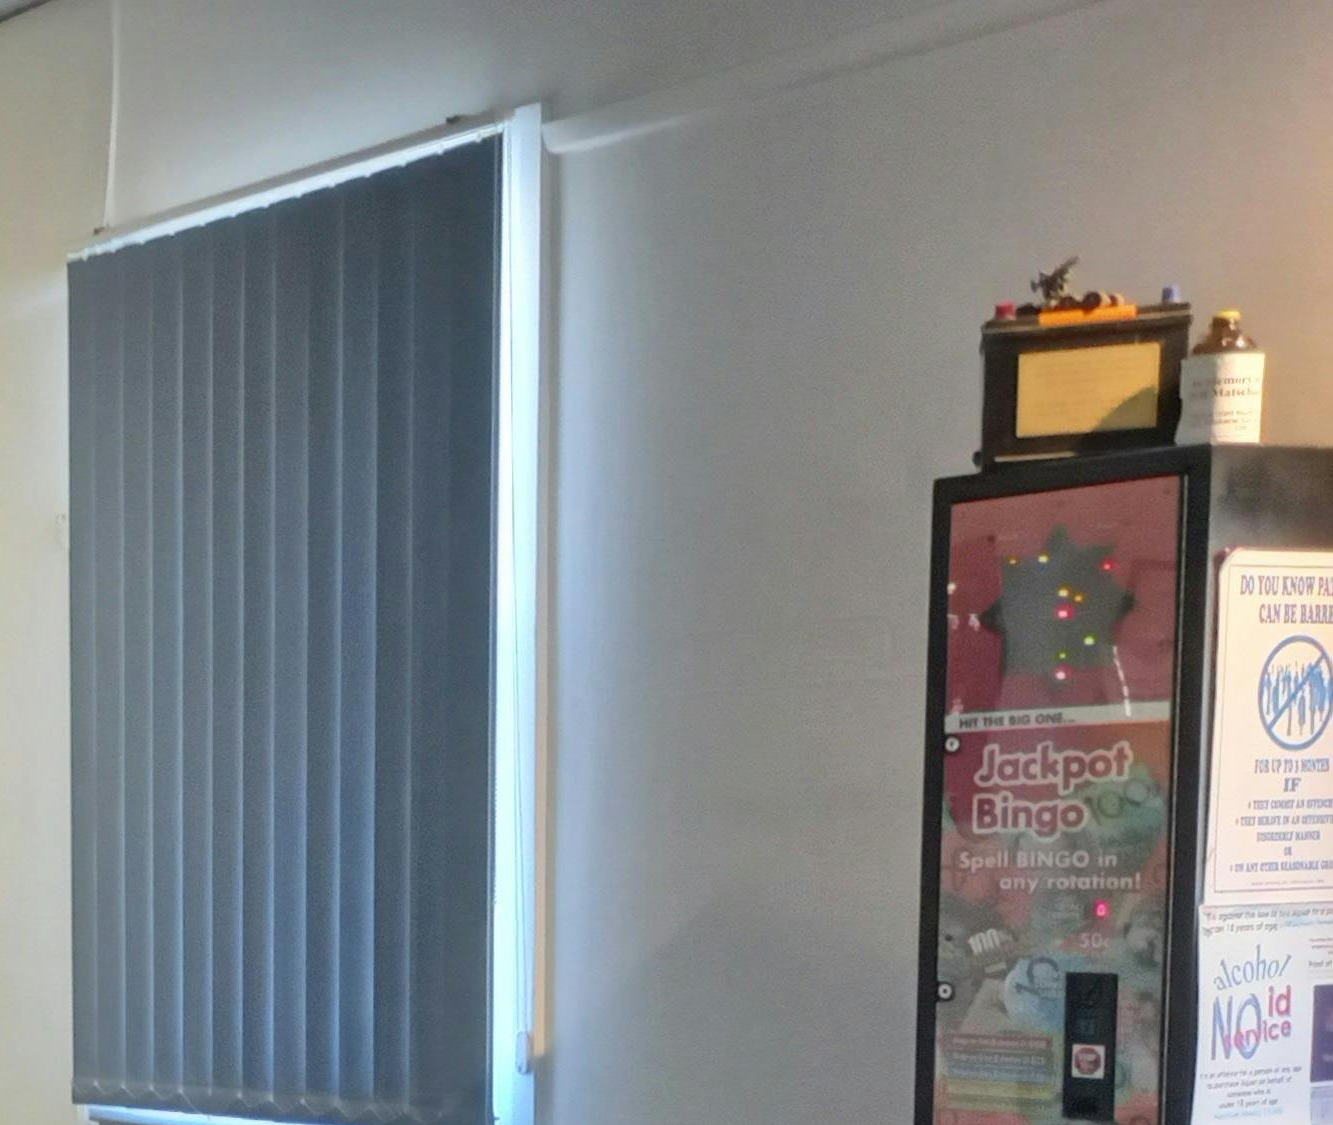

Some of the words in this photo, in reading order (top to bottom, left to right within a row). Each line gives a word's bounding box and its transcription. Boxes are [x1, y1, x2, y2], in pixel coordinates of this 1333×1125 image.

[1240, 574, 1255, 596] DO
[1257, 574, 1280, 596] YOU
[1282, 575, 1316, 596] KNOW
[1259, 603, 1282, 624] CAN
[1283, 604, 1297, 624] BE
[959, 716, 979, 729] HIT
[983, 715, 1005, 728] THE
[1008, 714, 1031, 727] BIG
[975, 741, 1131, 795] Jackpot
[1254, 758, 1269, 774] FOR
[1271, 758, 1281, 774] UP
[1284, 758, 1294, 773] TO
[1300, 758, 1329, 773] MONTHS
[1283, 777, 1302, 792] IF
[974, 792, 1090, 841] Bingo
[958, 851, 1009, 873] Spell
[1016, 850, 1090, 868] BINGO
[1097, 852, 1117, 867] in
[999, 878, 1040, 894] any
[1046, 872, 1142, 890] rotation!
[1213, 944, 1292, 990] alcohol
[1268, 985, 1292, 1018] id
